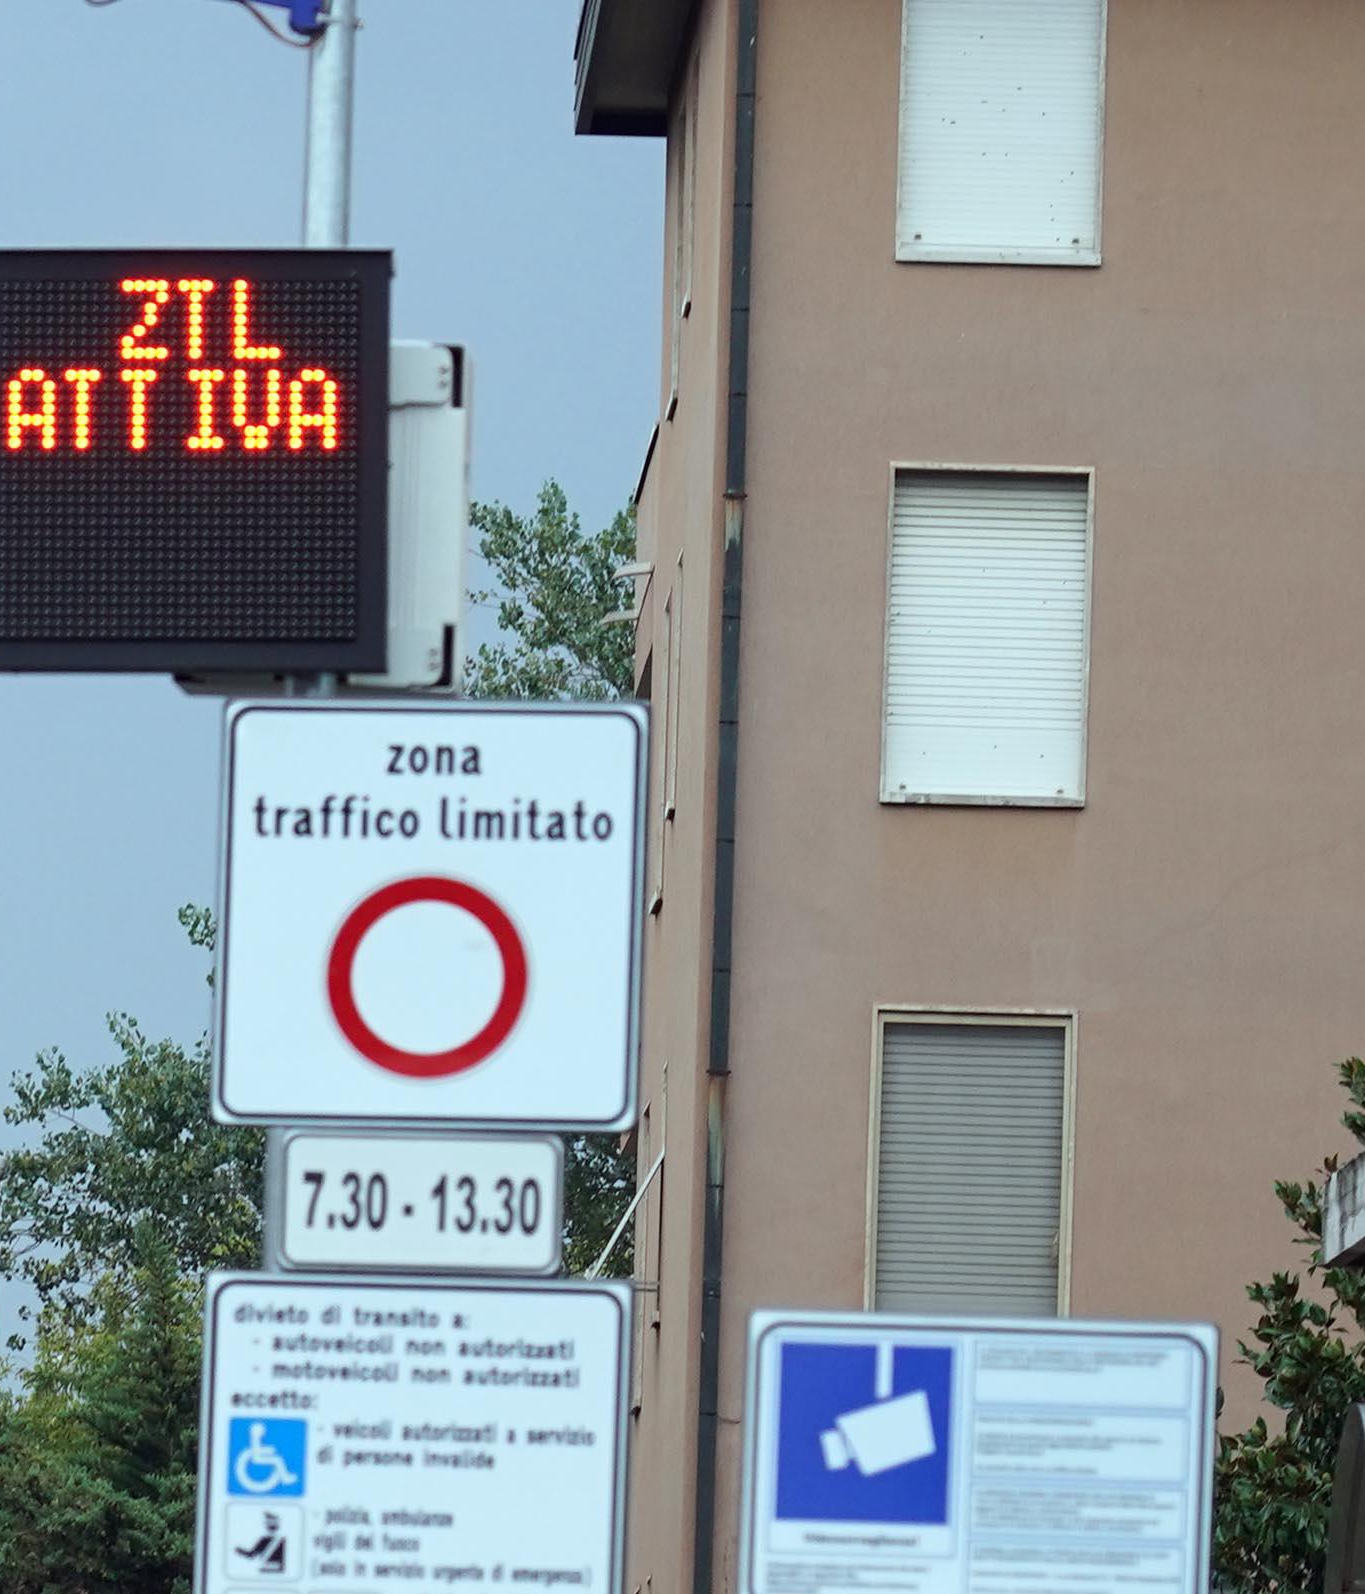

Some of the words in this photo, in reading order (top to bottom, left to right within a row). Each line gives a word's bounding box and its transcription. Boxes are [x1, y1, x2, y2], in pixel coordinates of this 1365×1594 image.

[121, 279, 281, 360] ZTL
[7, 368, 338, 450] ATTIVA
[386, 744, 482, 776] zona
[253, 795, 420, 839] traffico
[440, 797, 614, 842] limitato
[302, 1170, 389, 1232] 7.30
[431, 1174, 542, 1237] 13.30
[233, 1303, 310, 1325] divieto
[320, 1304, 342, 1326] di
[353, 1305, 441, 1329] transito
[271, 1332, 394, 1355] autoveicoli
[404, 1338, 447, 1357] non
[457, 1338, 576, 1361] autorizzati
[271, 1360, 399, 1383] motoveicoli
[410, 1366, 452, 1385] non
[462, 1366, 581, 1389] autorizzati
[230, 1389, 318, 1410] eccetto:
[342, 1450, 414, 1469] persone
